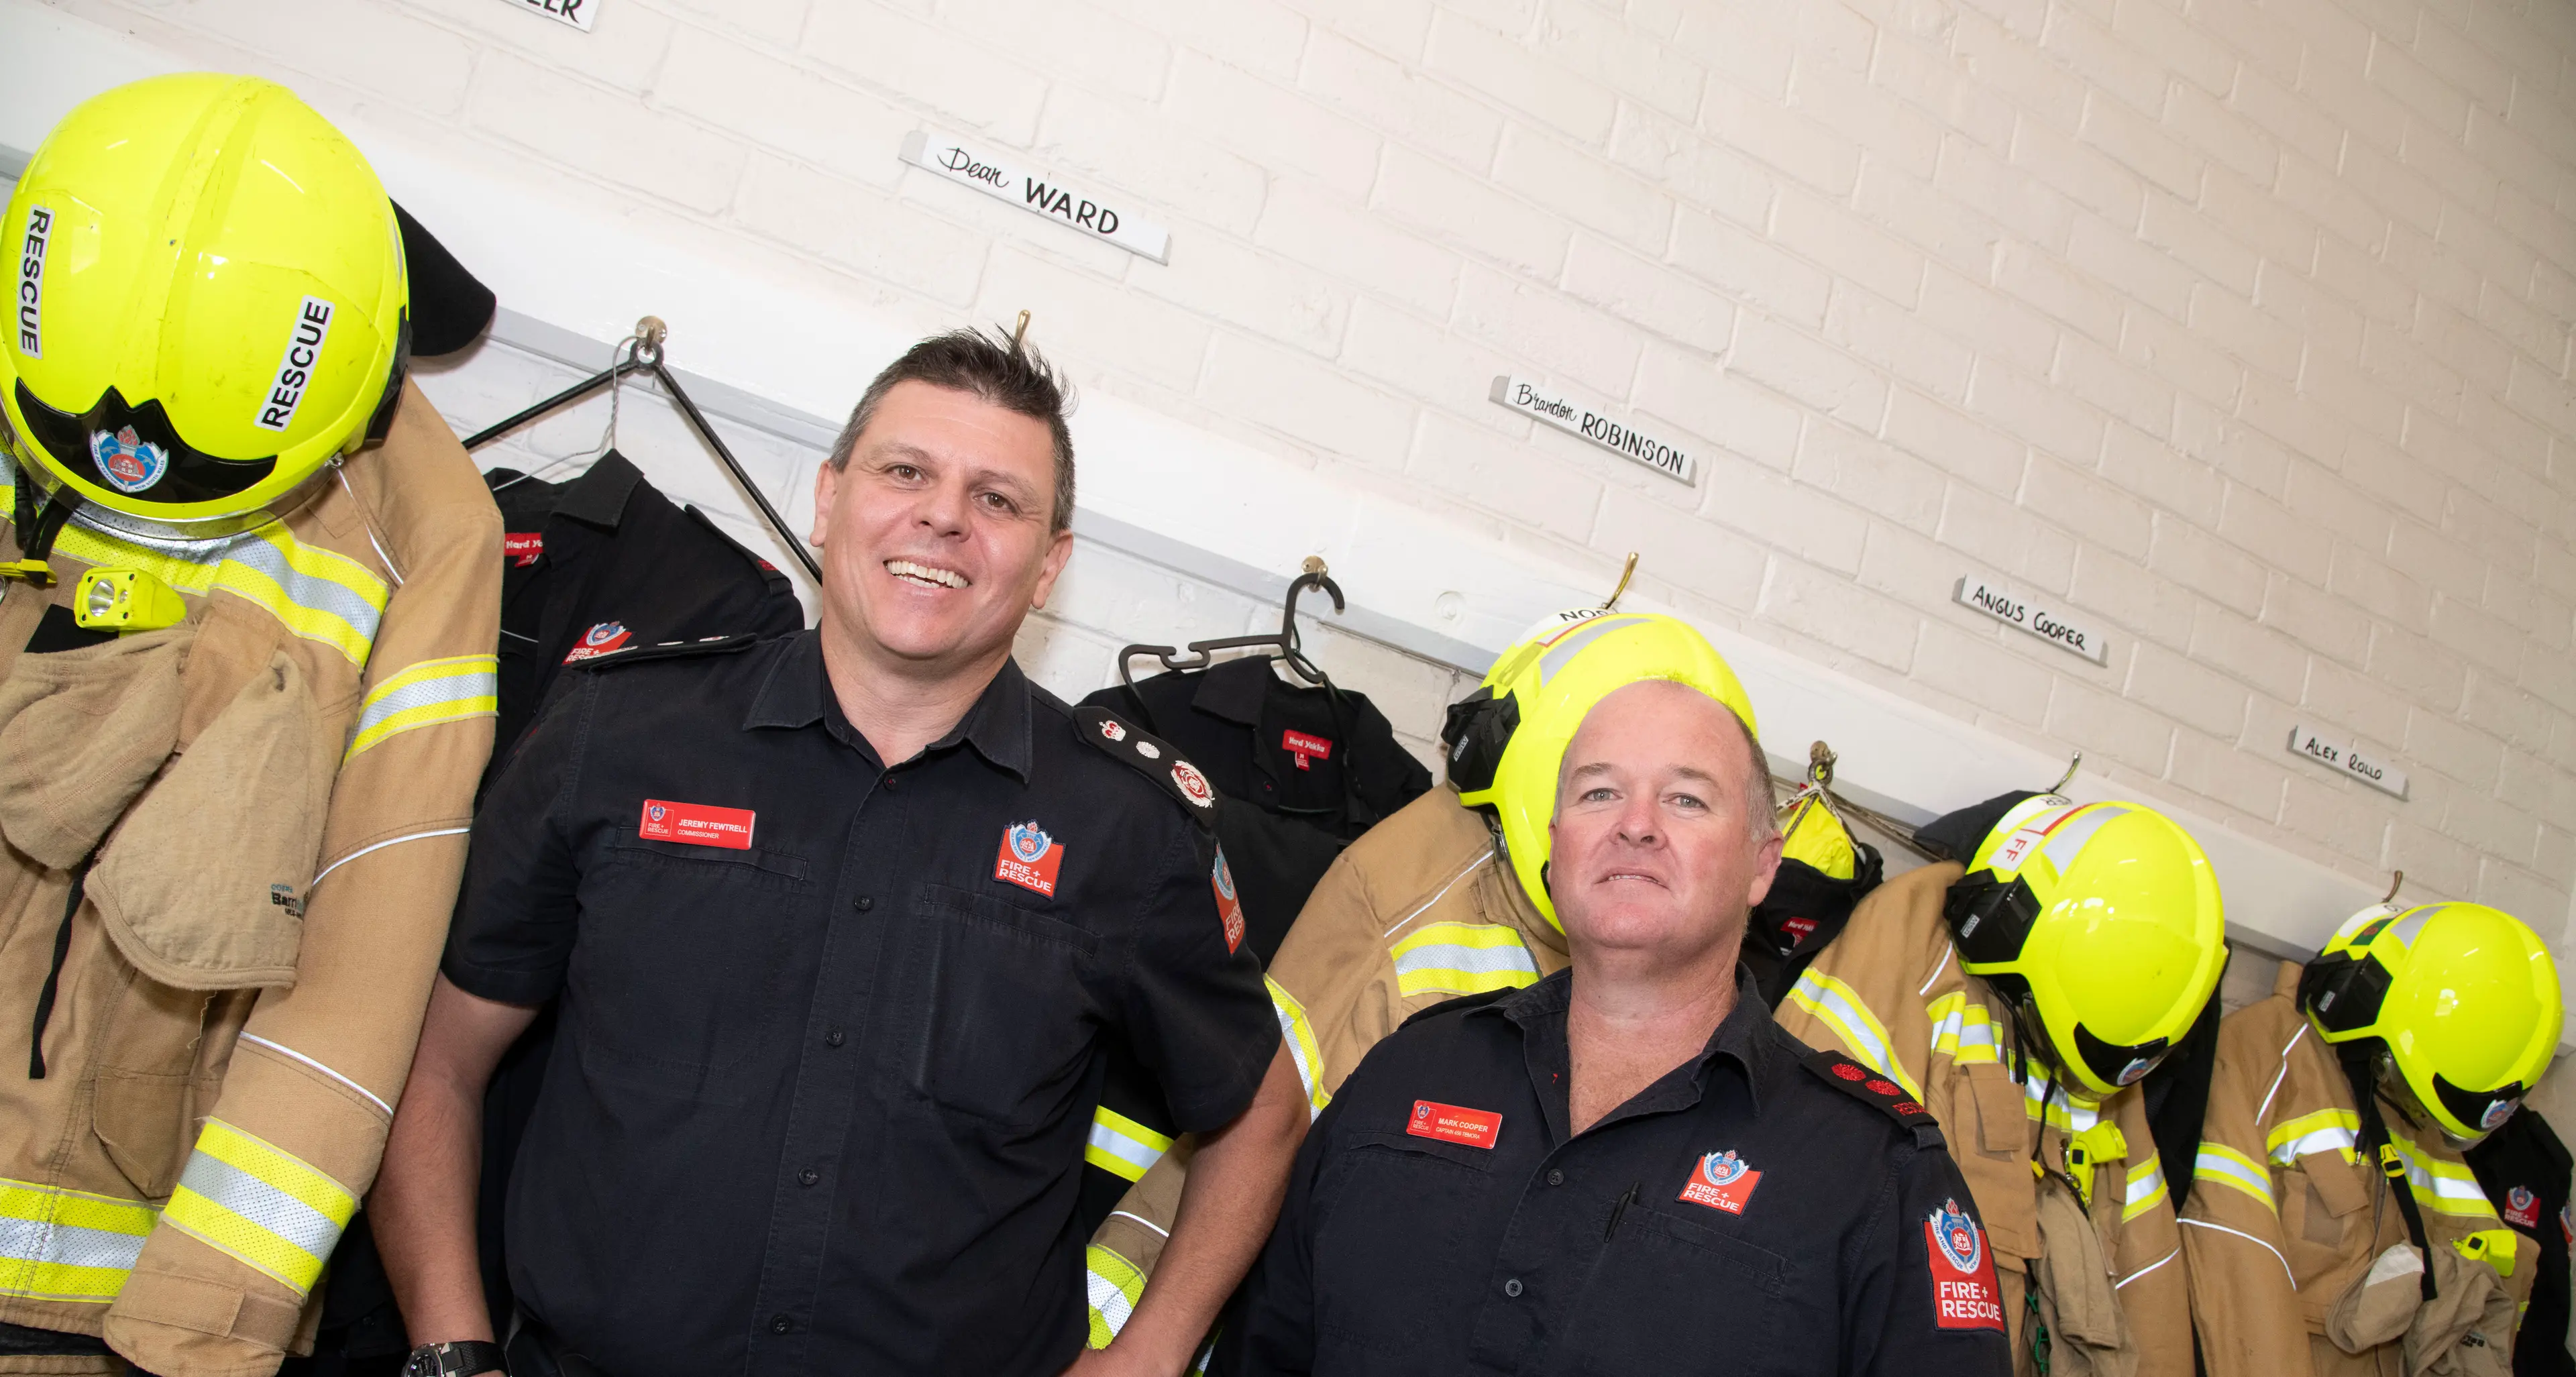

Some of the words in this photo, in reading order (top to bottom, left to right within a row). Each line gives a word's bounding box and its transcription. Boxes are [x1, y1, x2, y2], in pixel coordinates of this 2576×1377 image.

[937, 147, 1009, 187] Dean
[1026, 177, 1119, 234] WARD
[21, 210, 50, 353] RESCUE
[262, 301, 331, 429] RESCUE
[1513, 384, 1576, 421] Brandon
[1580, 412, 1684, 474] ROBINSON
[1972, 586, 2025, 622] ANGUS
[2034, 612, 2086, 651] COOPER
[1288, 736, 1303, 747] Hard
[2305, 737, 2338, 763] ALEX
[2349, 753, 2382, 780] ROLLO
[677, 829, 719, 839] COMMISSIONER
[678, 819, 709, 829] JEREMY
[709, 822, 748, 833] FEWTRELL
[1000, 859, 1031, 875] FIRE
[999, 868, 1052, 892] RESCUE
[1436, 1126, 1454, 1135] CAPTAIN
[1462, 1132, 1480, 1140] TEMORA
[1438, 1117, 1458, 1127] MARK
[1459, 1121, 1488, 1133] COOPER
[1688, 1182, 1720, 1197] FIRE
[1683, 1190, 1739, 1211] RESCUE
[1939, 1236, 1947, 1249] AND
[1946, 1249, 1964, 1270] RESCUE
[1940, 1281, 1980, 1299] FIRE
[1941, 1299, 2001, 1321] RESCUE
